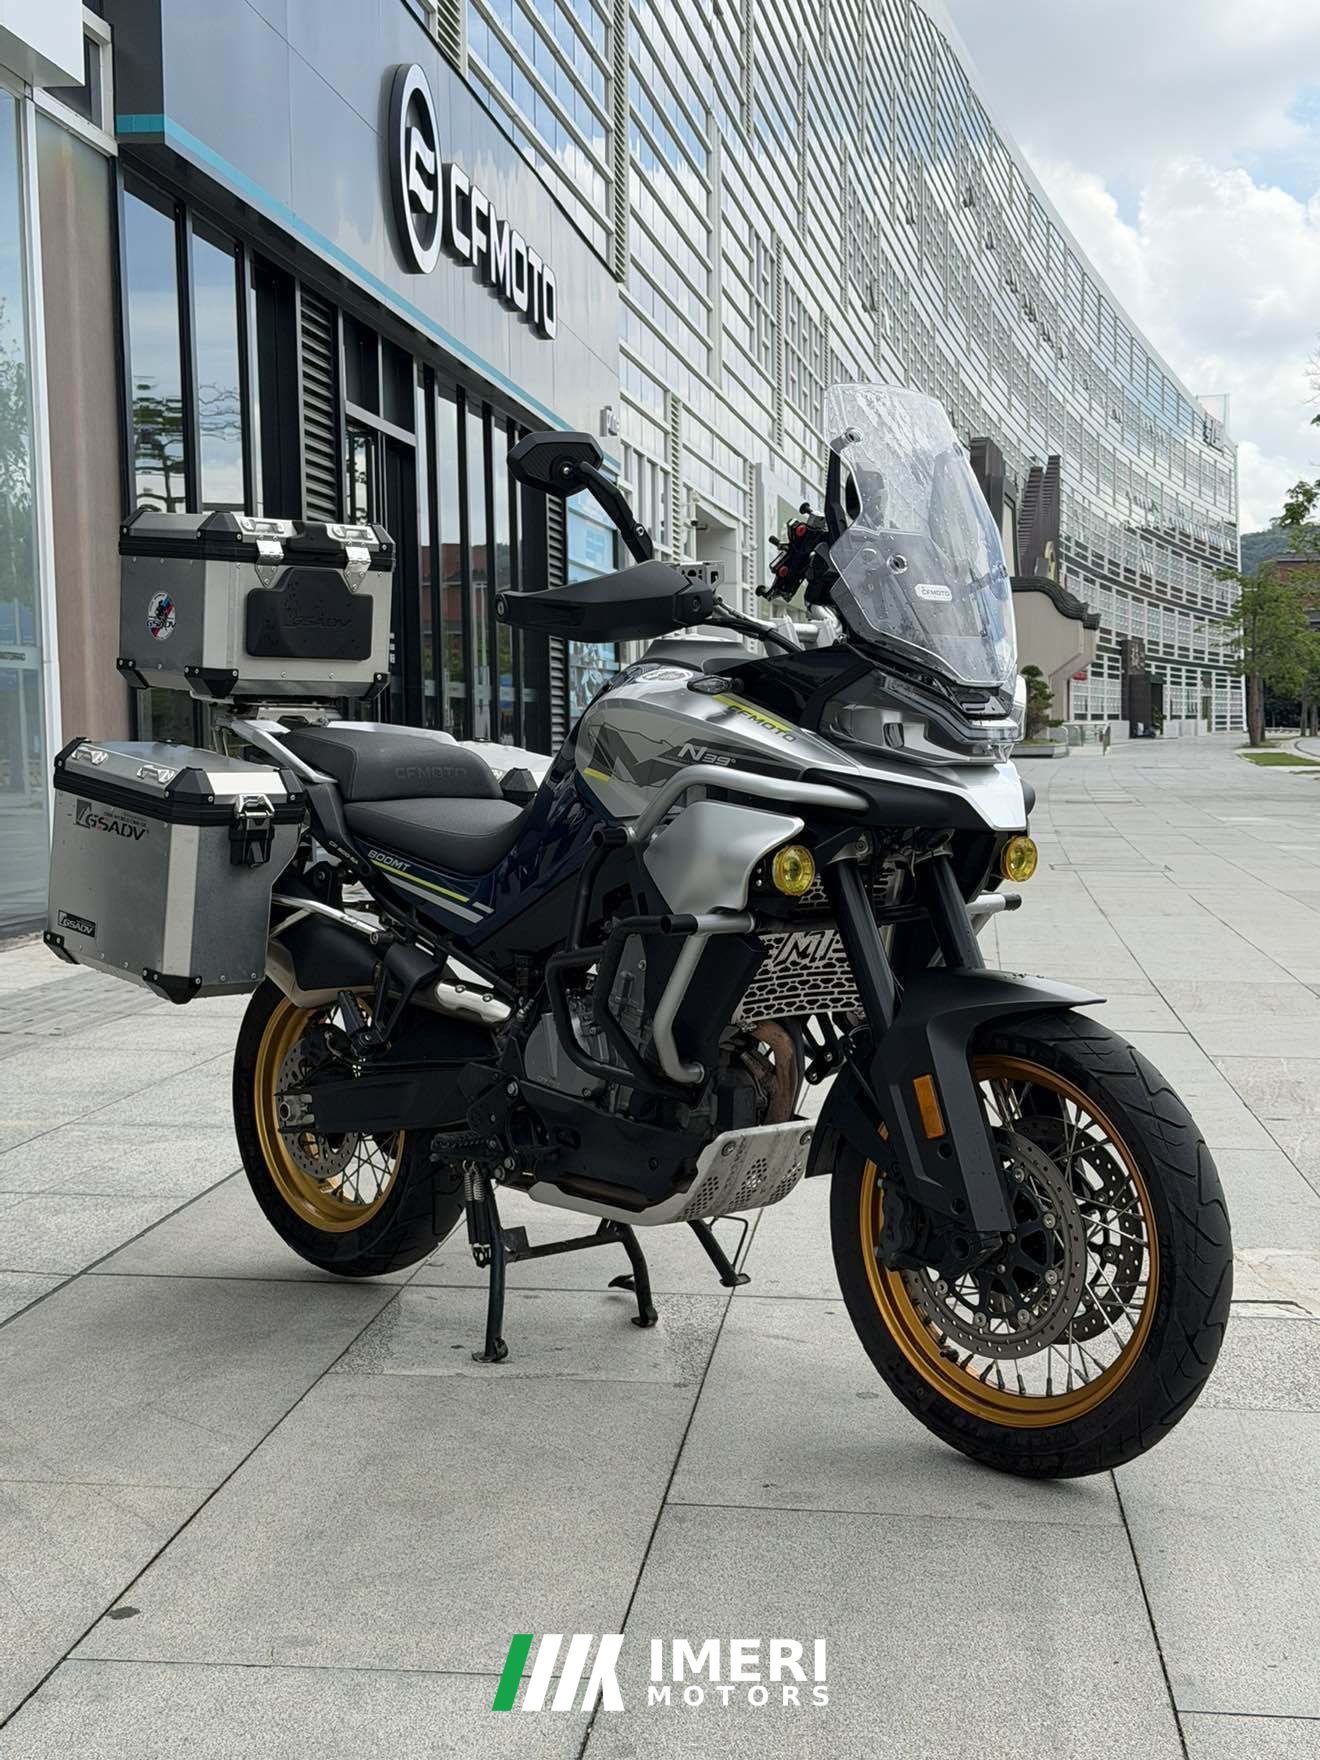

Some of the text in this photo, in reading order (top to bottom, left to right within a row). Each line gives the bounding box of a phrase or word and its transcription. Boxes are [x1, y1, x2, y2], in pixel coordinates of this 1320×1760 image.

[449, 163, 557, 341] CFMOTO
[727, 704, 797, 743] CFMOTO
[394, 765, 468, 780] CFMOTO
